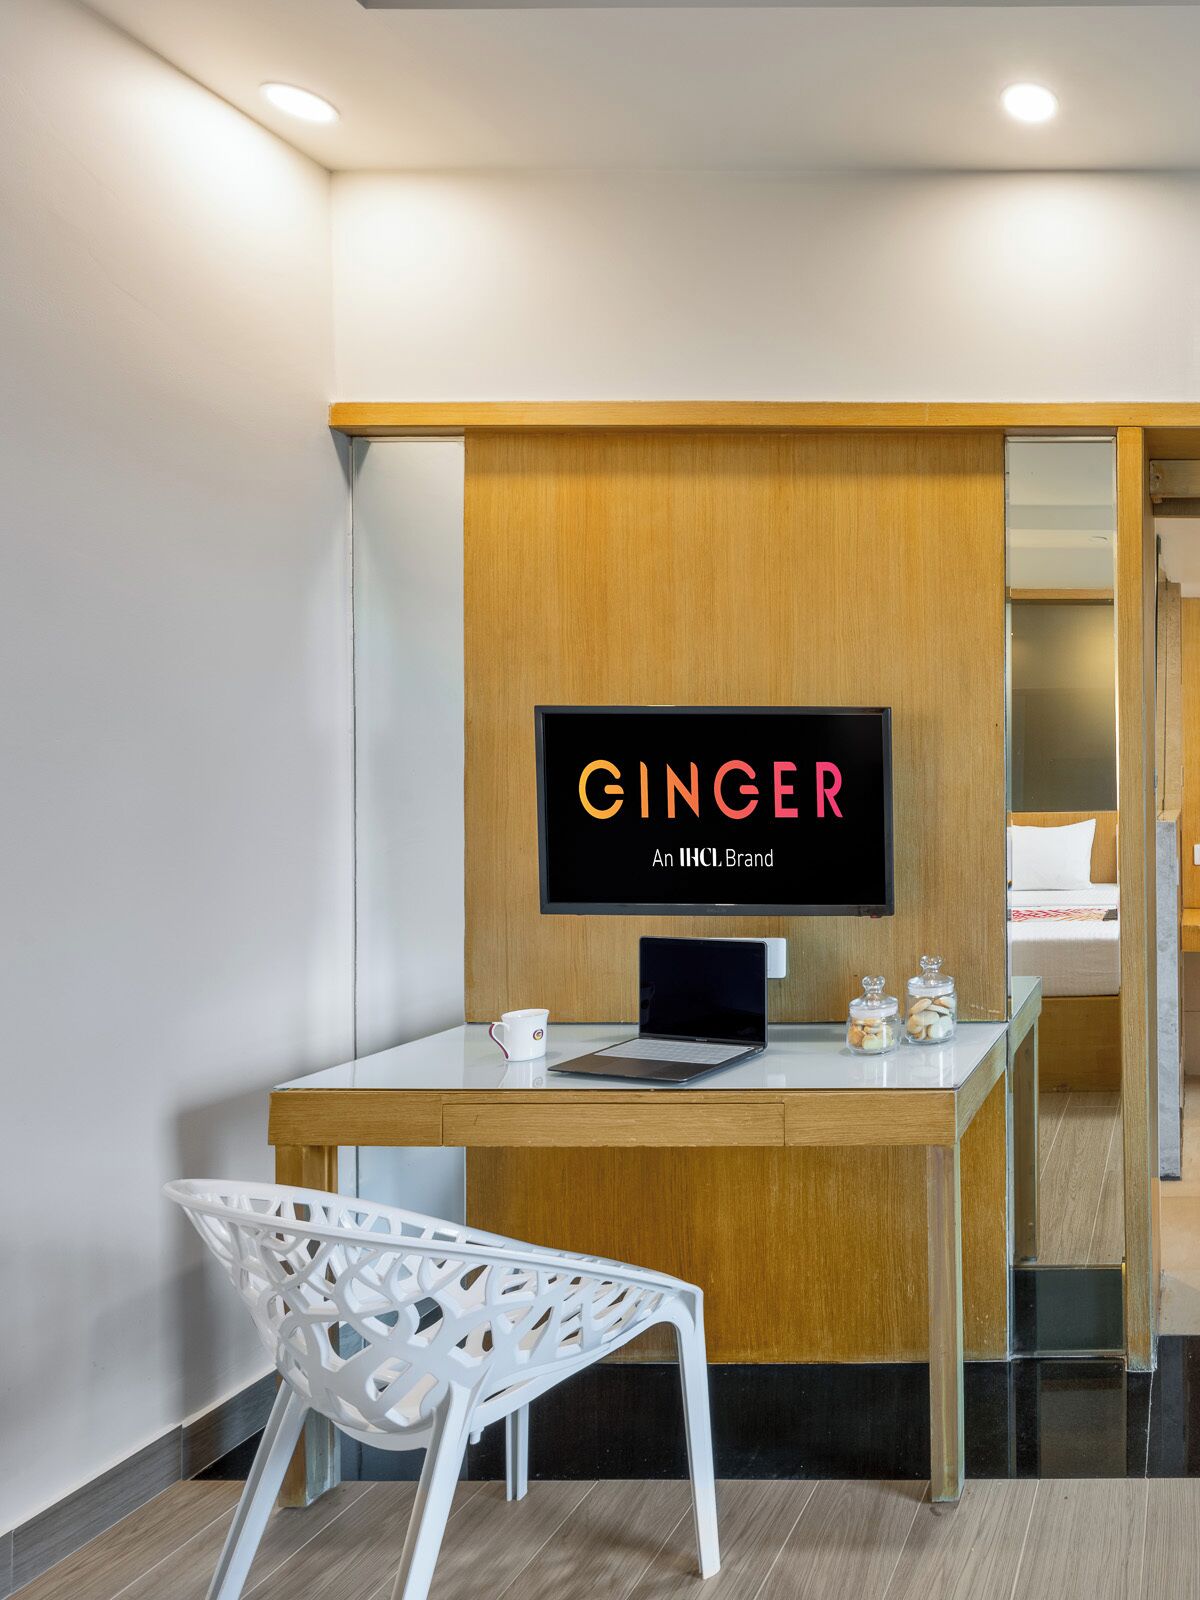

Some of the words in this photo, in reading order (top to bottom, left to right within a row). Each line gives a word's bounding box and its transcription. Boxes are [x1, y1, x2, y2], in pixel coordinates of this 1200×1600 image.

[578, 759, 844, 820] GINGER
[652, 848, 674, 867] An
[679, 847, 723, 867] IHCL
[725, 848, 774, 868] Brand
